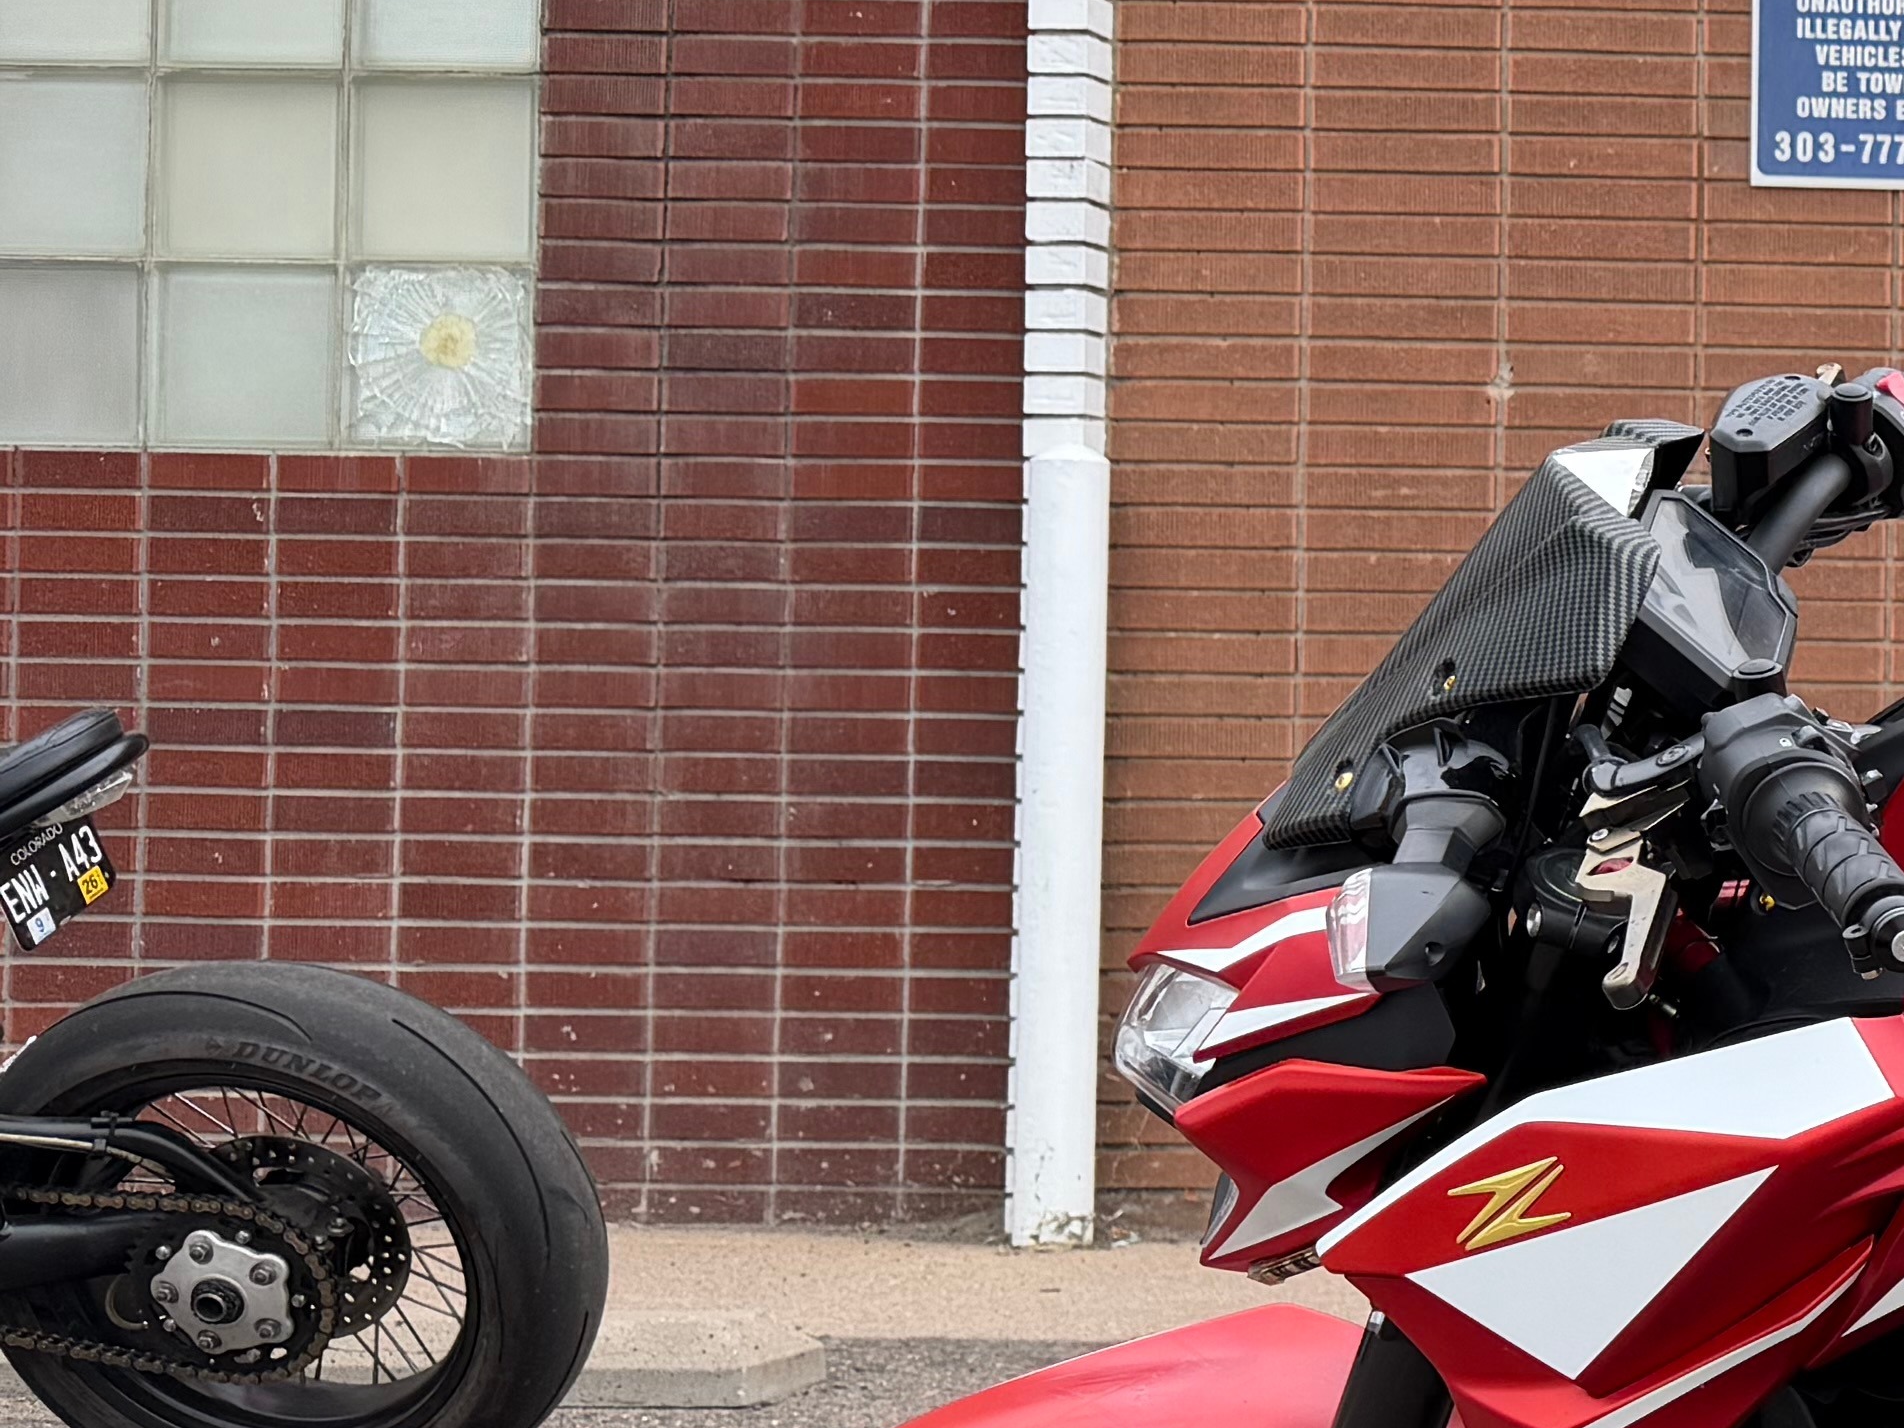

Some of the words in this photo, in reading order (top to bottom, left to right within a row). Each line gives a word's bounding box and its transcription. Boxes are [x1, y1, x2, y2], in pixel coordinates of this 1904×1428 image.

[1797, 18, 1902, 42] ILLEGALLY
[1821, 71, 1848, 92] BE
[1796, 96, 1887, 120] OWNERS
[10, 822, 63, 866] COLORADO
[0, 864, 50, 924] ENW
[58, 825, 103, 882] A43
[82, 874, 98, 894] 26
[233, 1041, 382, 1102] DUNLOP
